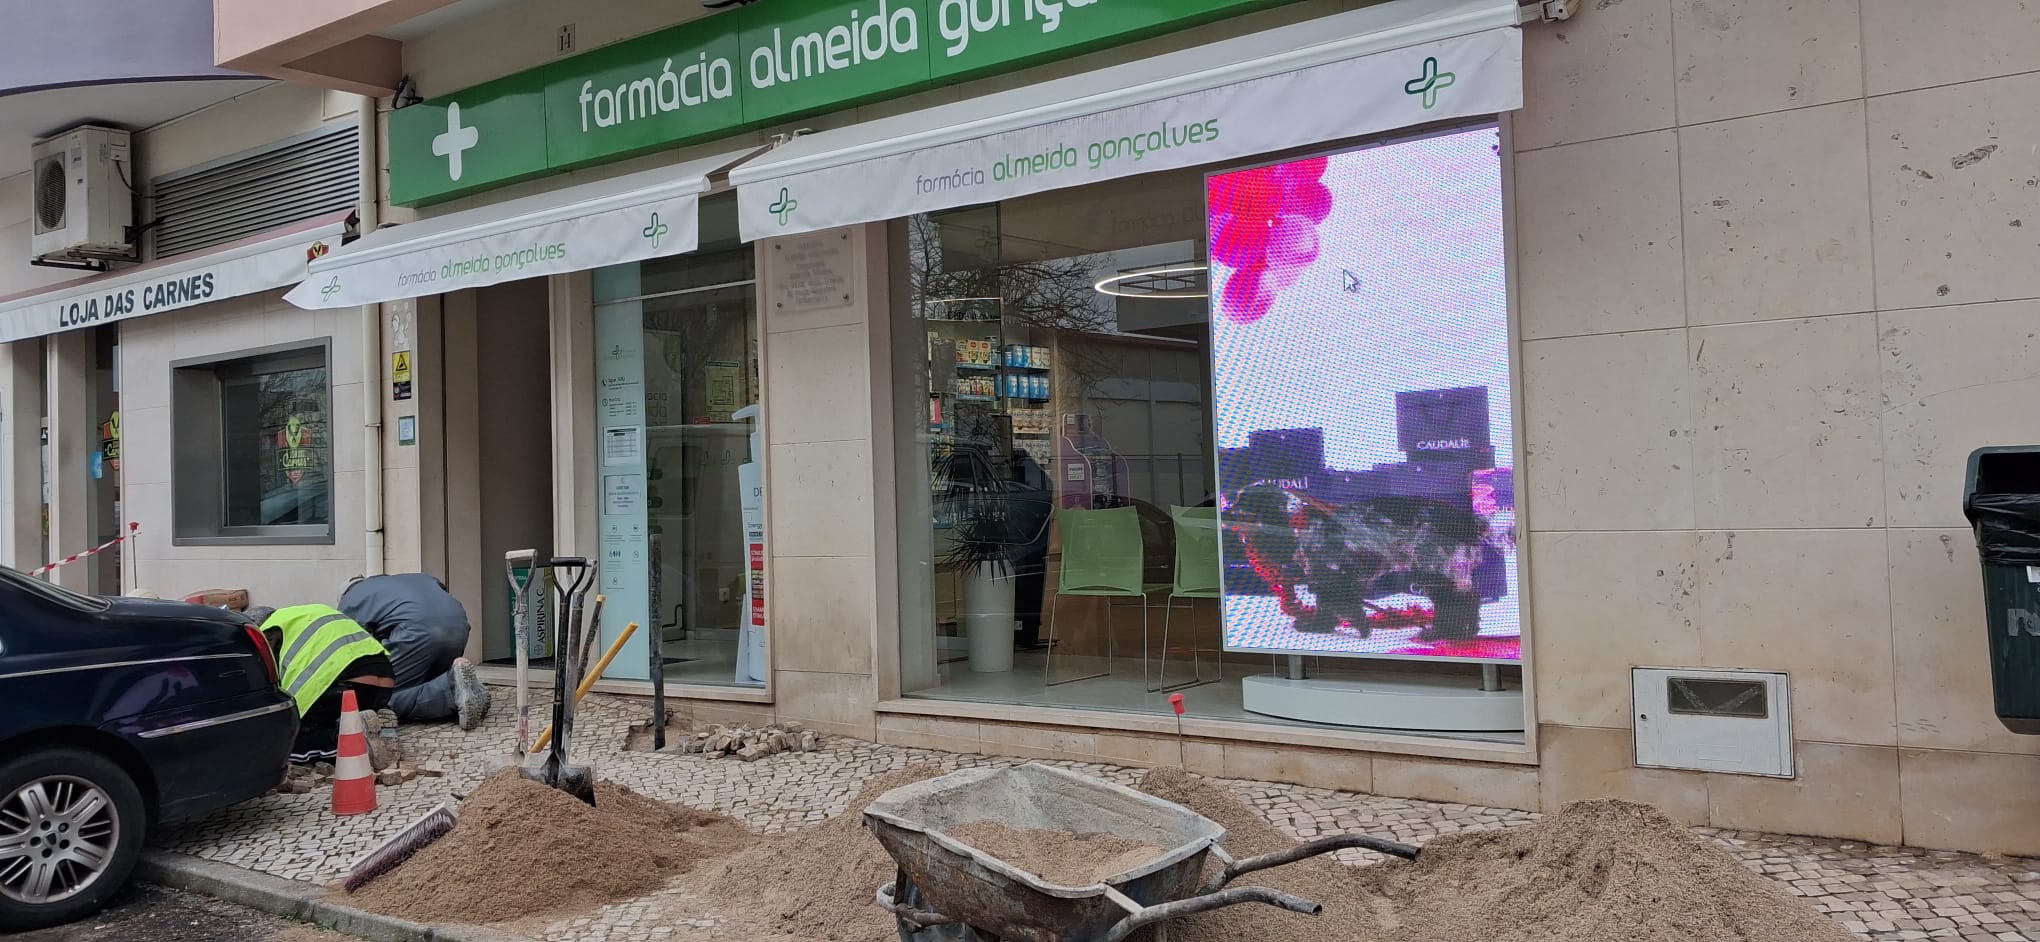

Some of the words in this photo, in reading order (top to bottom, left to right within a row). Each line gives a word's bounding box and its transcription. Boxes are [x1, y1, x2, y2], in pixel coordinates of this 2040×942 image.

[579, 52, 732, 133] farmácia
[750, 0, 918, 89] almeida
[939, 0, 1097, 57] gonç
[916, 167, 985, 196] farmácia
[993, 143, 1077, 182] almeida
[1087, 118, 1219, 170] gonçalves
[398, 268, 437, 287] farmácia
[441, 253, 489, 280] almeida
[494, 242, 566, 275] gonçalves
[59, 298, 99, 327] LOJA
[104, 289, 135, 318] DAS
[143, 272, 214, 311] CARNES
